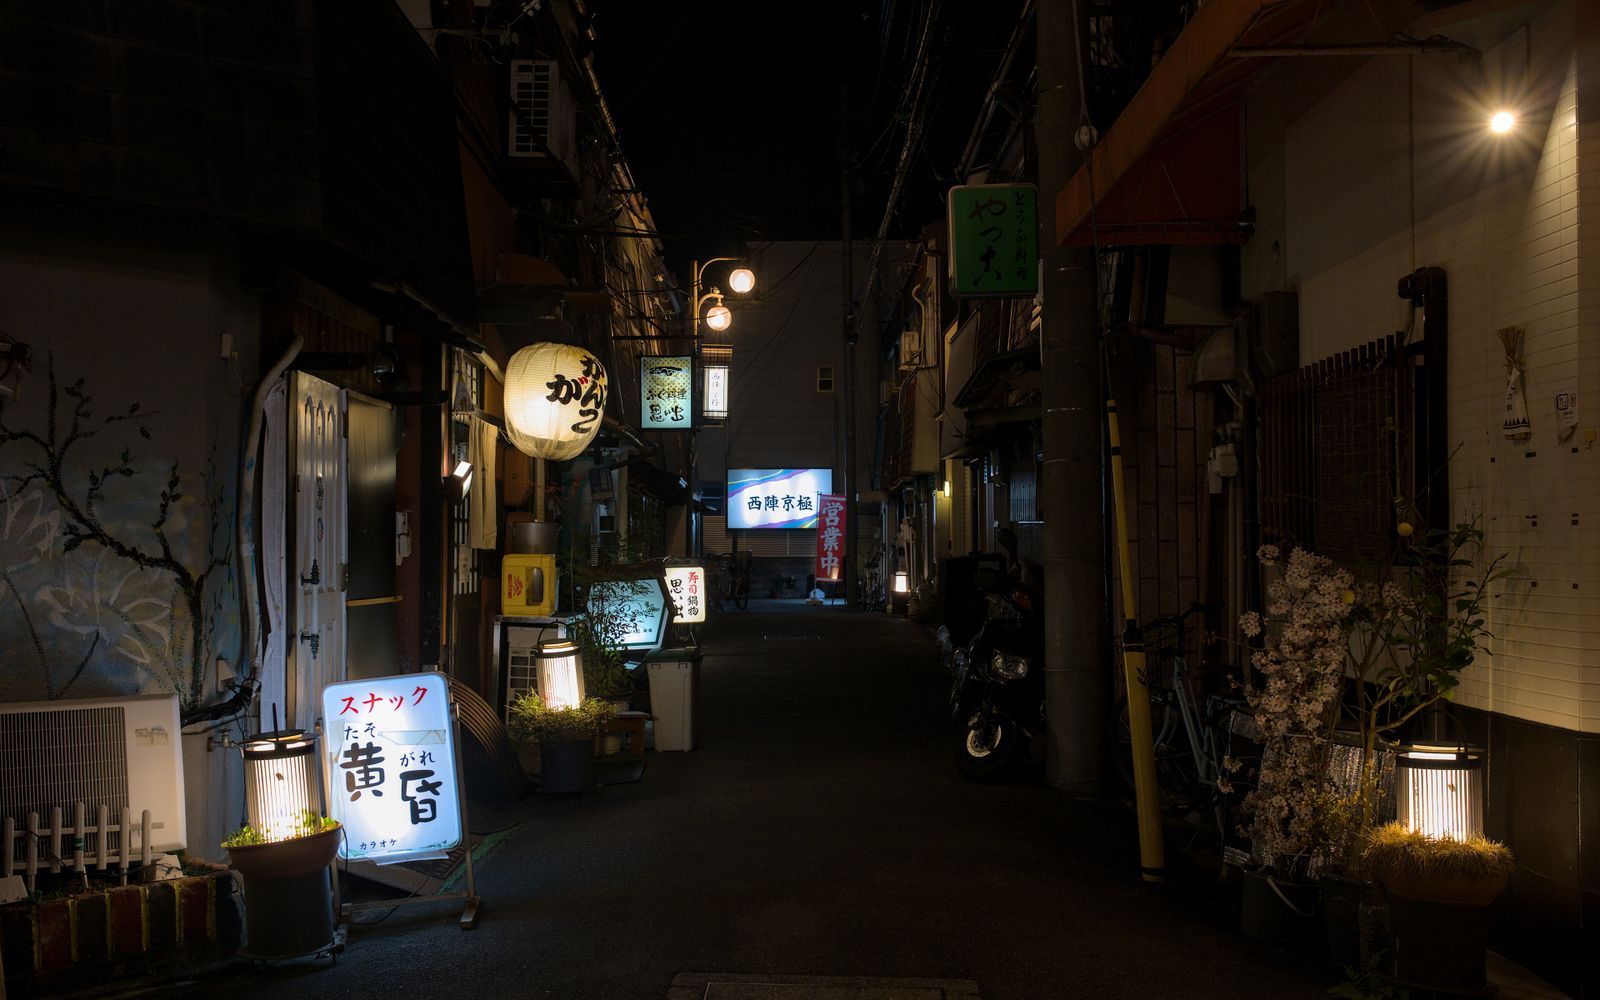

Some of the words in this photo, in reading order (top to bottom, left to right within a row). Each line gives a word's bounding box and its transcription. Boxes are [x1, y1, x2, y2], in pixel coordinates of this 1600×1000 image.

[747, 495, 813, 512] 西陣京極
[820, 502, 844, 576] 営業中
[339, 686, 428, 716] スナック
[400, 751, 435, 768] がれ
[359, 838, 397, 851] カラオケ
